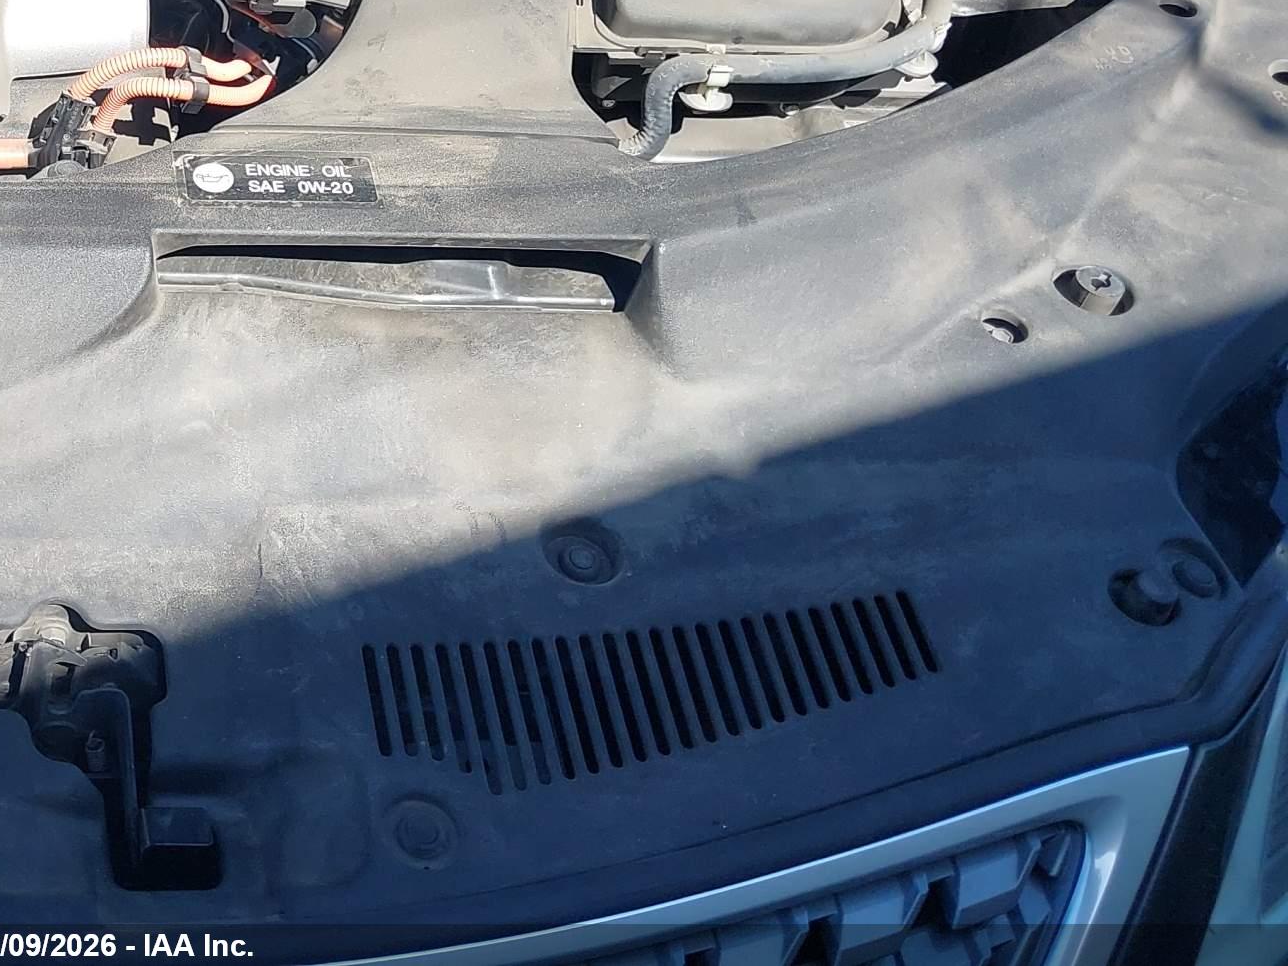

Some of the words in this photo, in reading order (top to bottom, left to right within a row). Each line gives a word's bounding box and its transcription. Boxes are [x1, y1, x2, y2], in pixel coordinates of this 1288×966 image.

[245, 163, 311, 177] ENGINE
[321, 165, 352, 178] OIL
[248, 180, 286, 193] SAE
[298, 181, 354, 194] 0W-20
